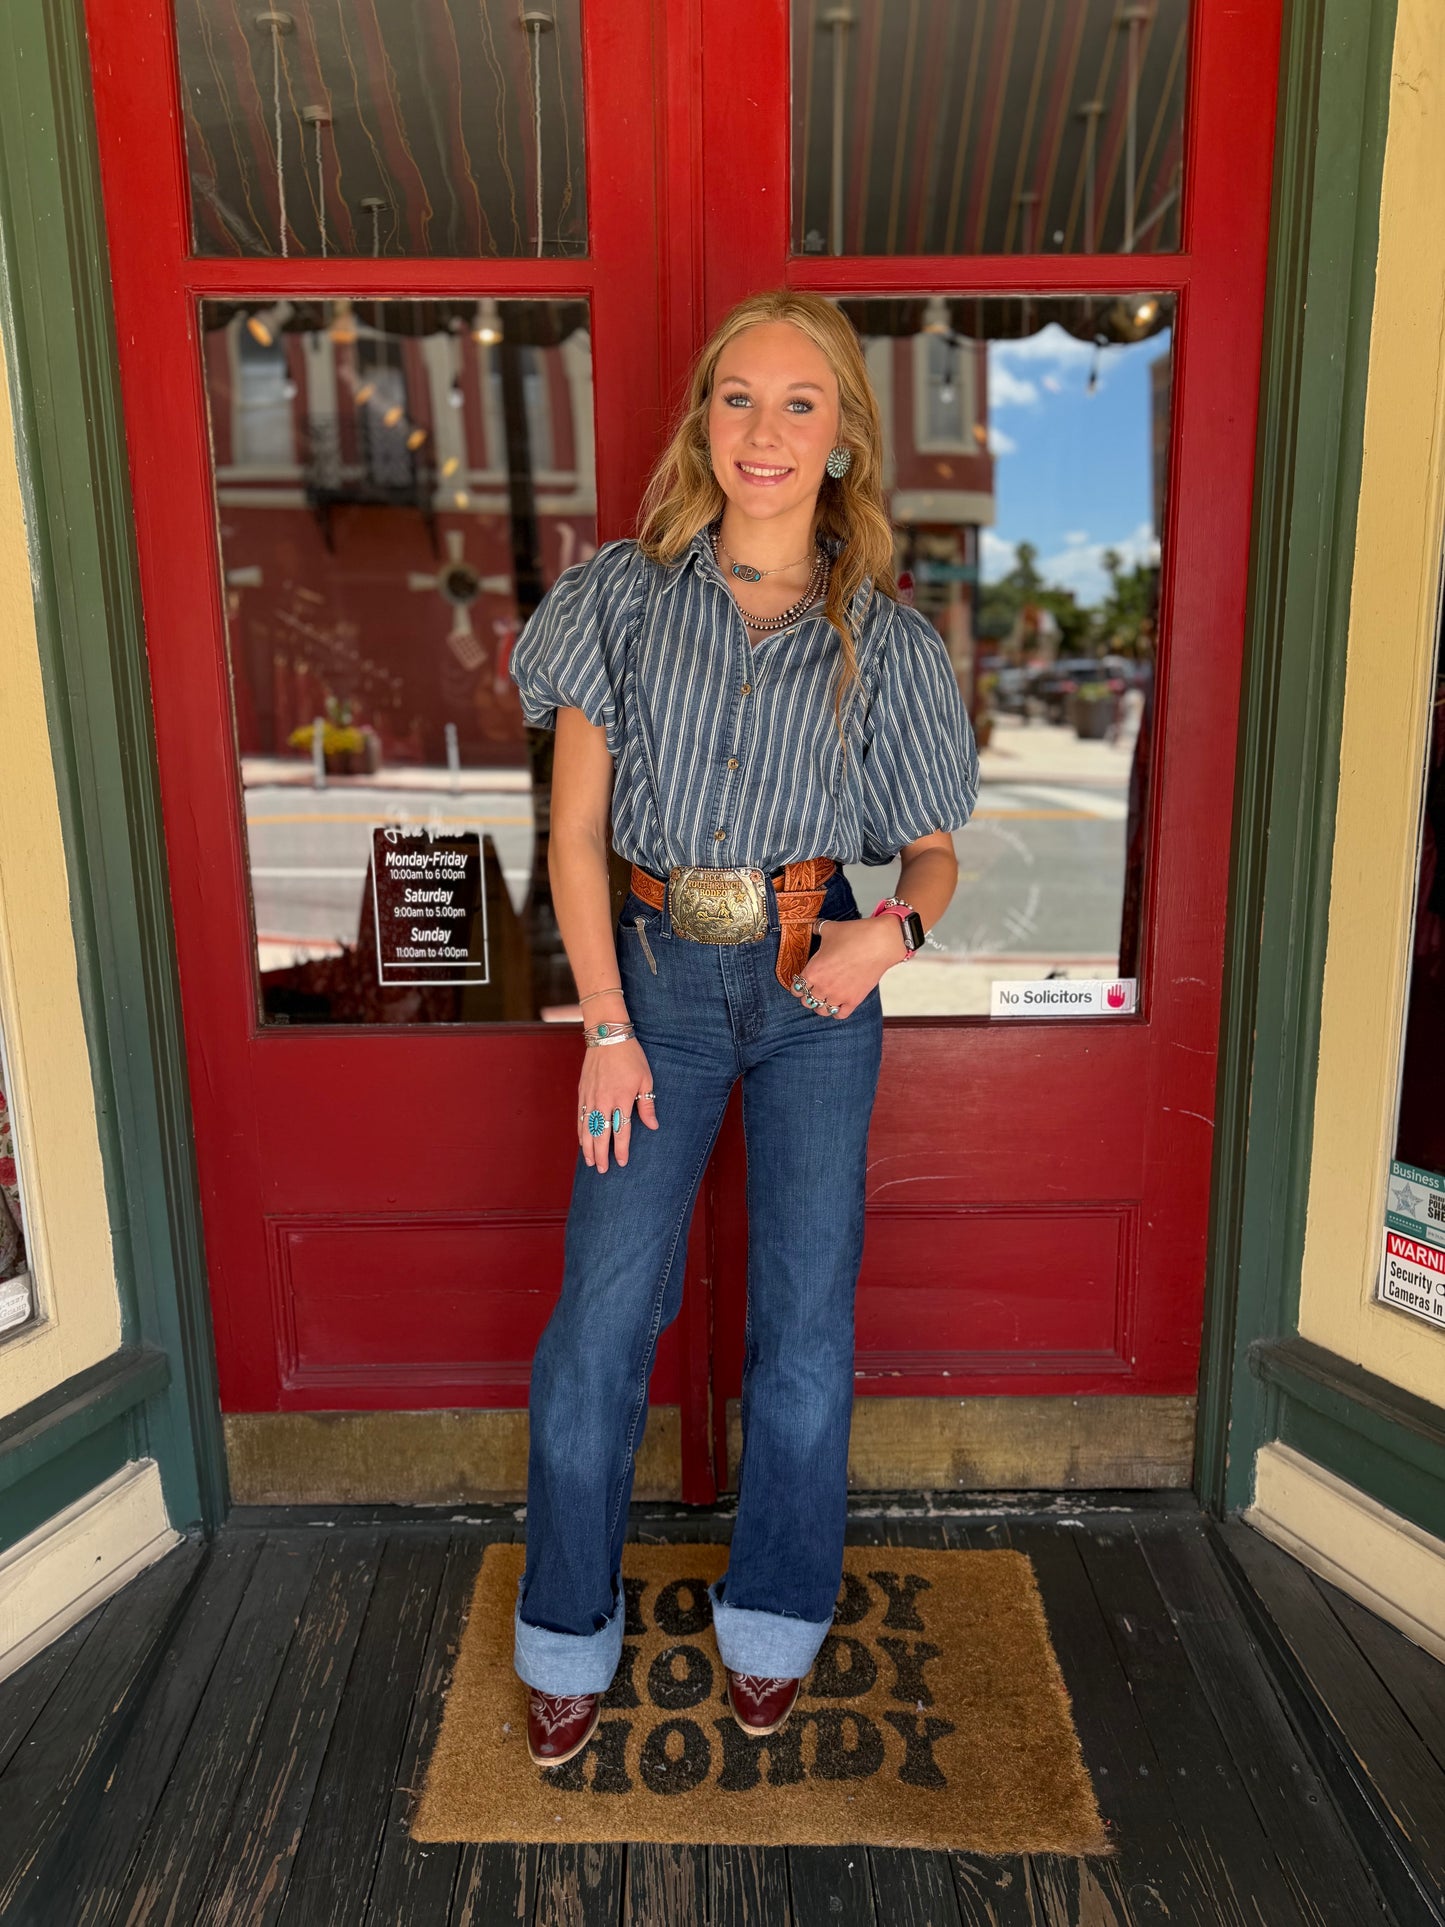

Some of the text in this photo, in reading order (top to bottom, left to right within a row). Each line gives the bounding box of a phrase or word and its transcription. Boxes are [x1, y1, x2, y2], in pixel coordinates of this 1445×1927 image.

[385, 851, 468, 869] Monday-Friday
[390, 868, 466, 881] 10:00am to 600pm
[404, 887, 454, 905] Saturday
[700, 889, 728, 897] RODEO
[394, 906, 424, 918] 9:00am
[425, 907, 434, 918] to
[410, 926, 452, 944] Sunday
[427, 947, 436, 958] to
[1000, 990, 1092, 1005] No Solicitors
[1393, 1162, 1440, 1188] Business
[1390, 1234, 1445, 1273] WARNI
[1390, 1260, 1432, 1294] Security
[1389, 1280, 1443, 1316] Cameras In
